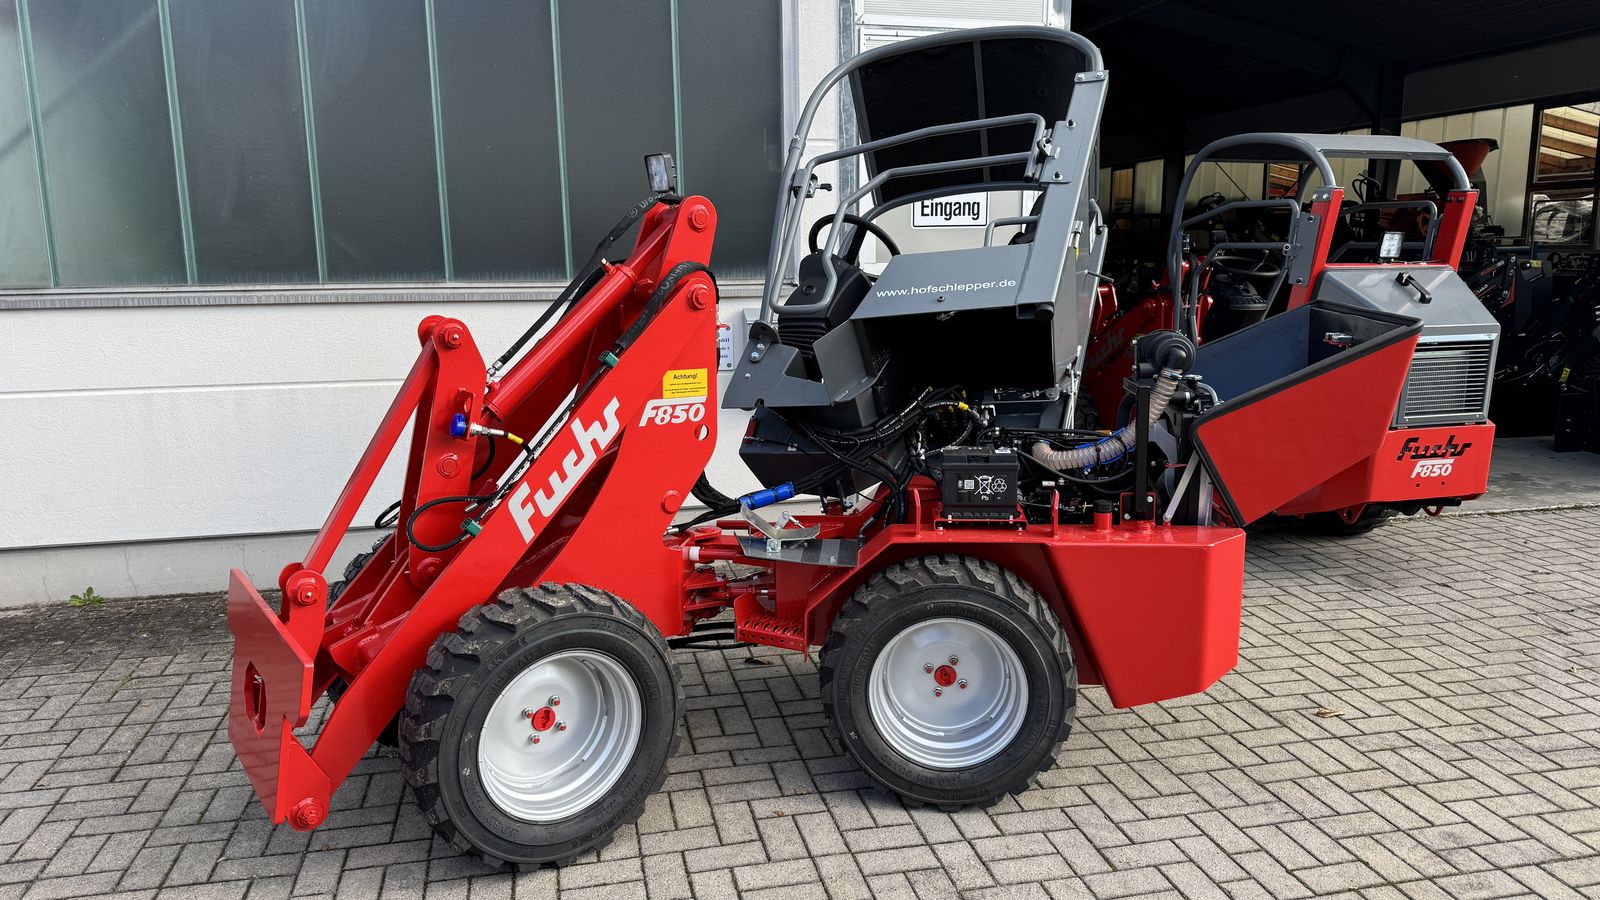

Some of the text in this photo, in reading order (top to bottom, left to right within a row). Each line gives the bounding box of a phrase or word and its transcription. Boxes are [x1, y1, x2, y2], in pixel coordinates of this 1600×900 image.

[920, 199, 981, 221] Eingang
[876, 279, 1016, 297] www.hofschlepper.de
[638, 396, 708, 427] F850
[1396, 435, 1472, 461] Fuchs
[508, 396, 620, 544] Fuchs
[1410, 459, 1455, 478] F850
